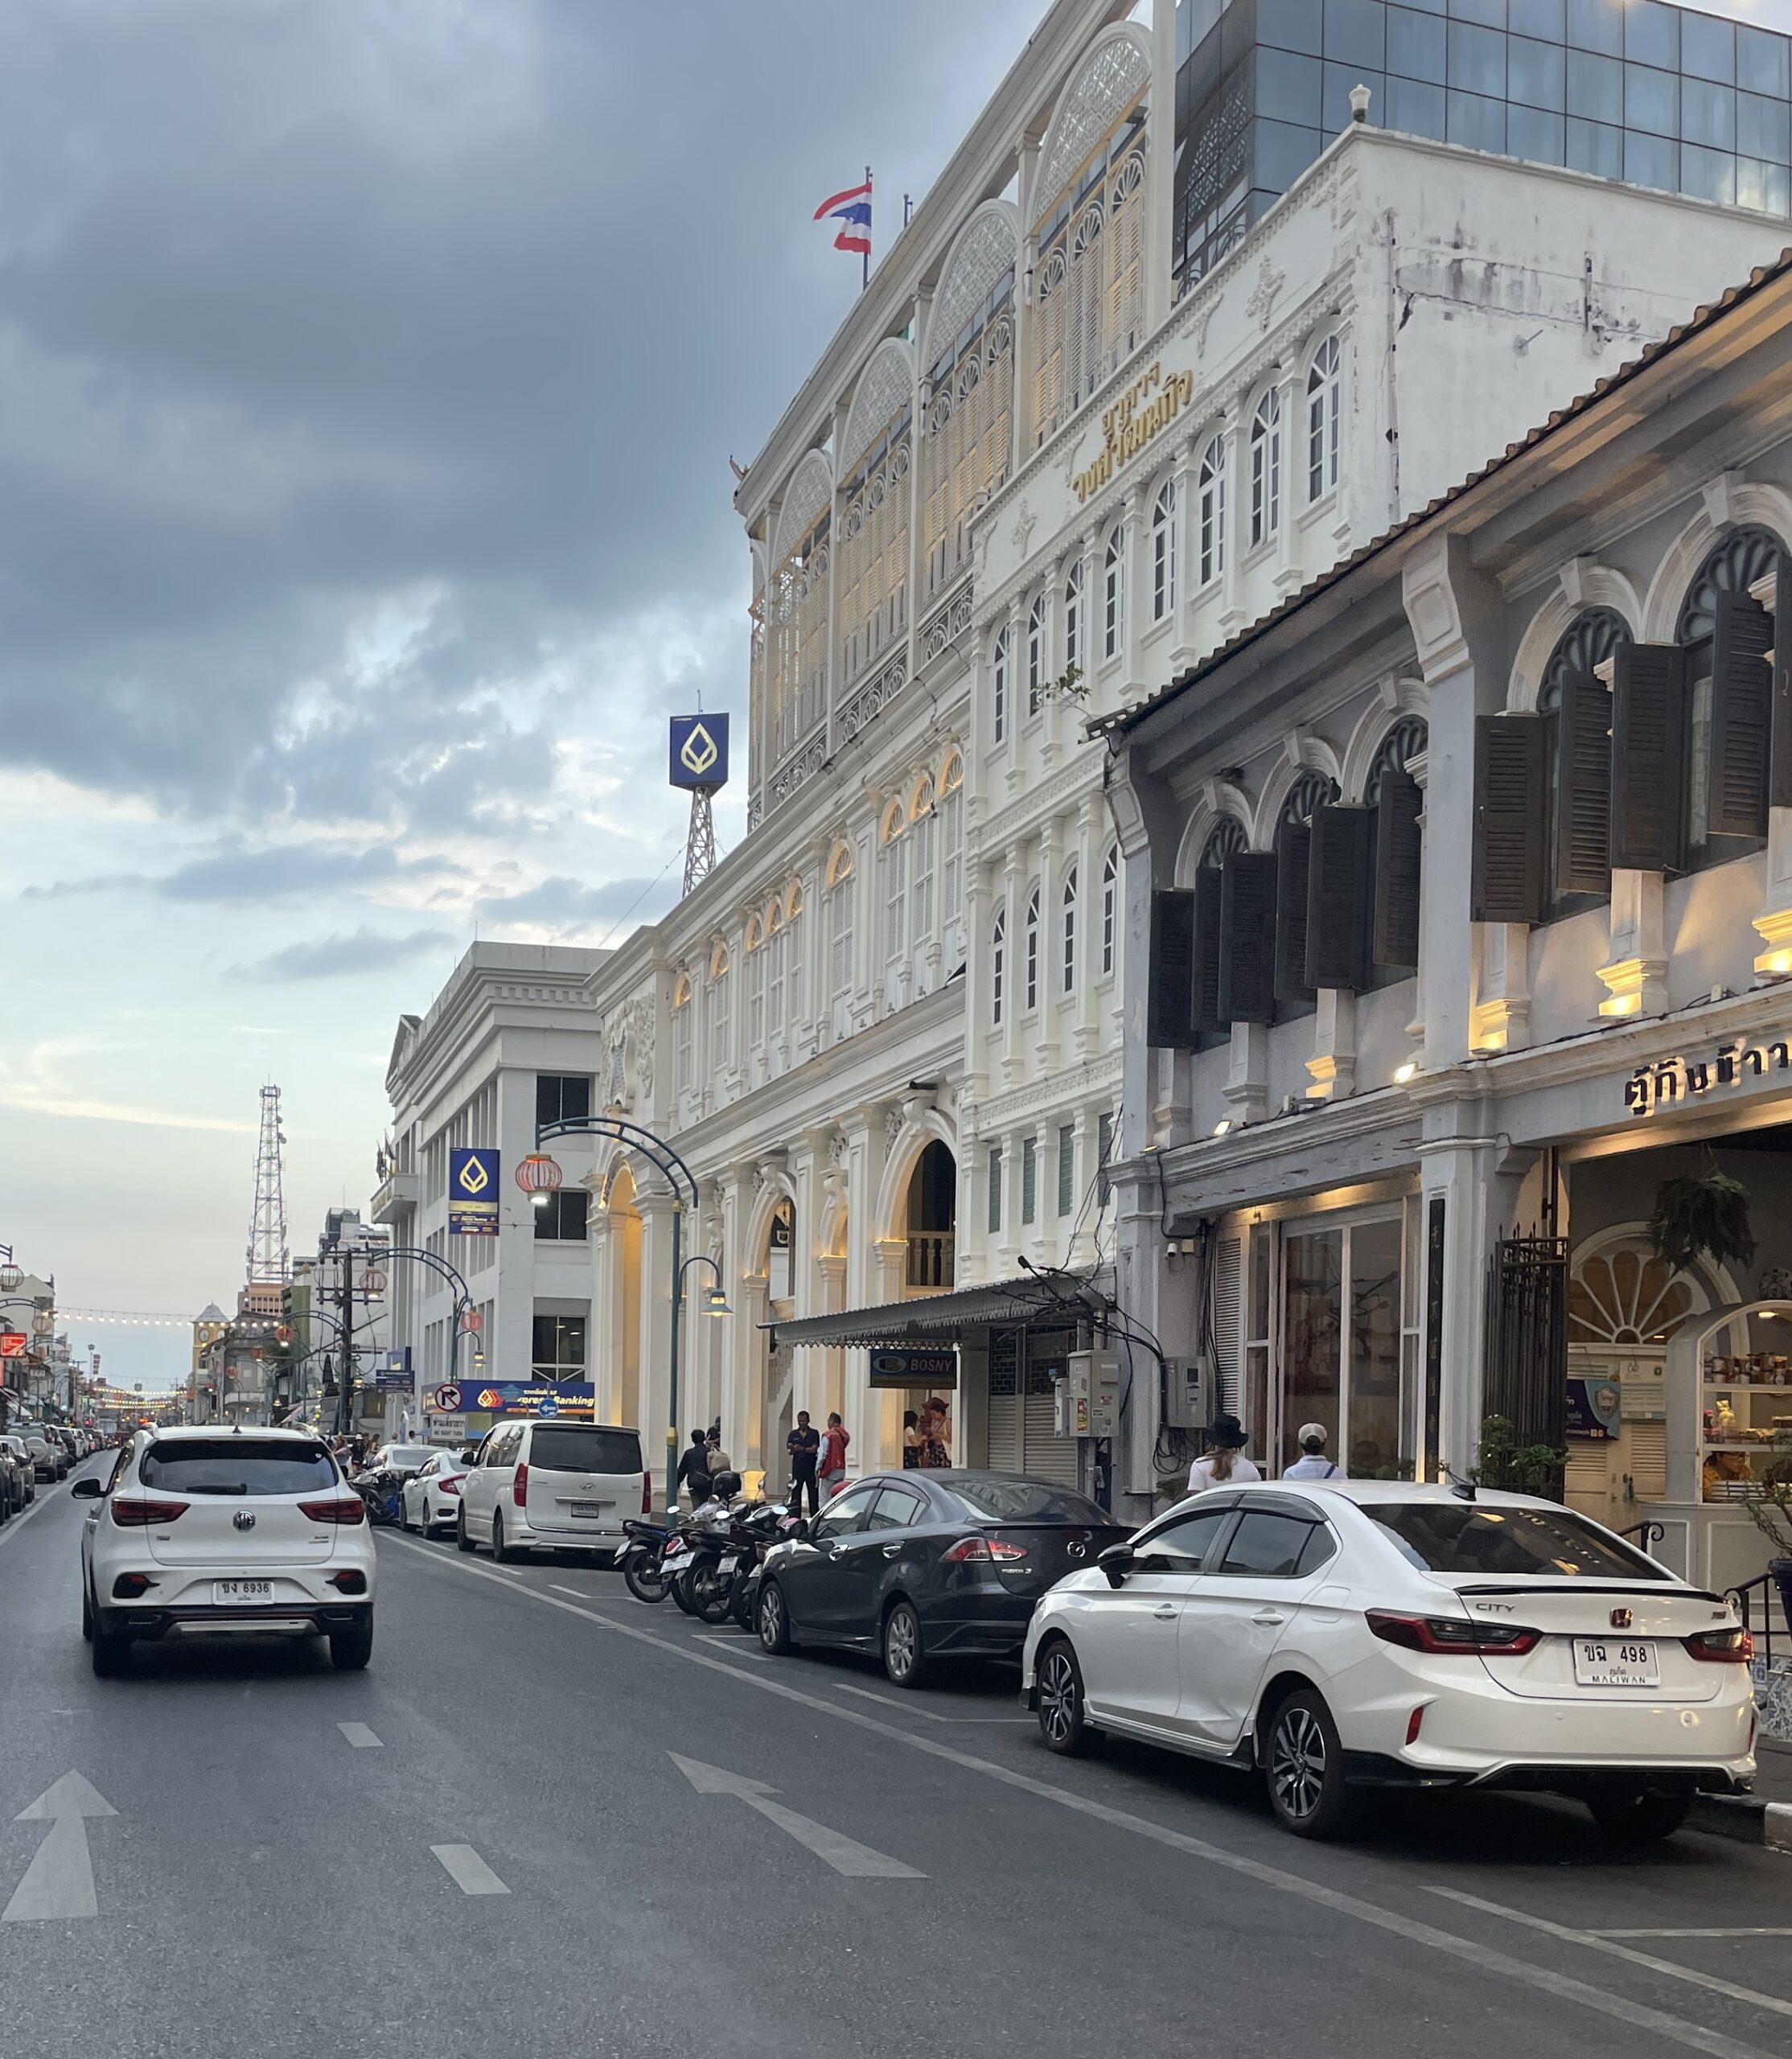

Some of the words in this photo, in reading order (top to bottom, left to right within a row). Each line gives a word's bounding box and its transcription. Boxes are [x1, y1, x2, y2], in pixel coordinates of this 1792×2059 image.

[1102, 361, 1160, 435] อาคาร
[1625, 1042, 1788, 1115] ตู้กับข้าว
[910, 1358, 953, 1372] BOSNY
[553, 1395, 595, 1407] Banking
[244, 1583, 269, 1593] 6936
[1476, 1603, 1515, 1612] CITY
[1620, 1646, 1647, 1662] 498
[1592, 1675, 1646, 1684] MALIWAN
